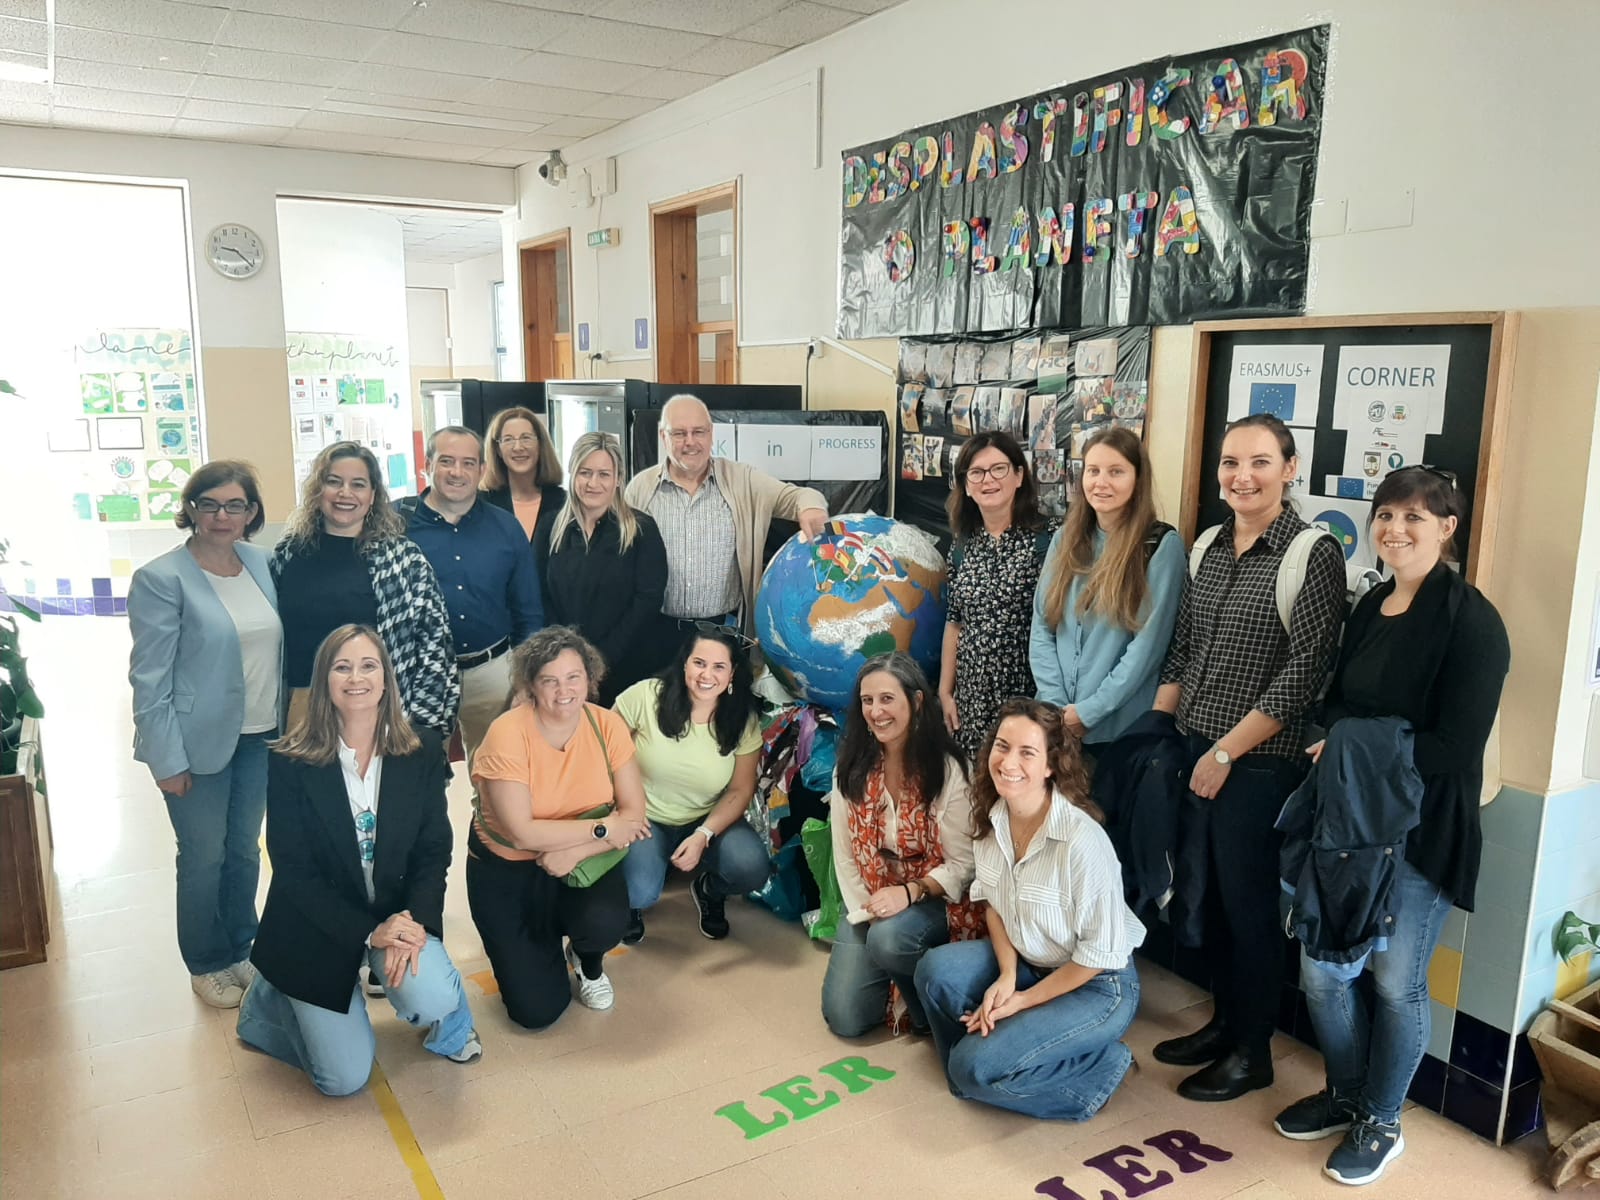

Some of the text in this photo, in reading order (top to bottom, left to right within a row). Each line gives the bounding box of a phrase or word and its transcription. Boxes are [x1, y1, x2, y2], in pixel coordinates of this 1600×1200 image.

[842, 48, 1309, 208] DESPLASTIFICAR
[883, 185, 1201, 283] O PLANETA
[1239, 362, 1312, 377] ERASMUS+
[1347, 366, 1435, 388] CORNER
[767, 438, 876, 457] in PROGRESS
[714, 1056, 896, 1140] LER
